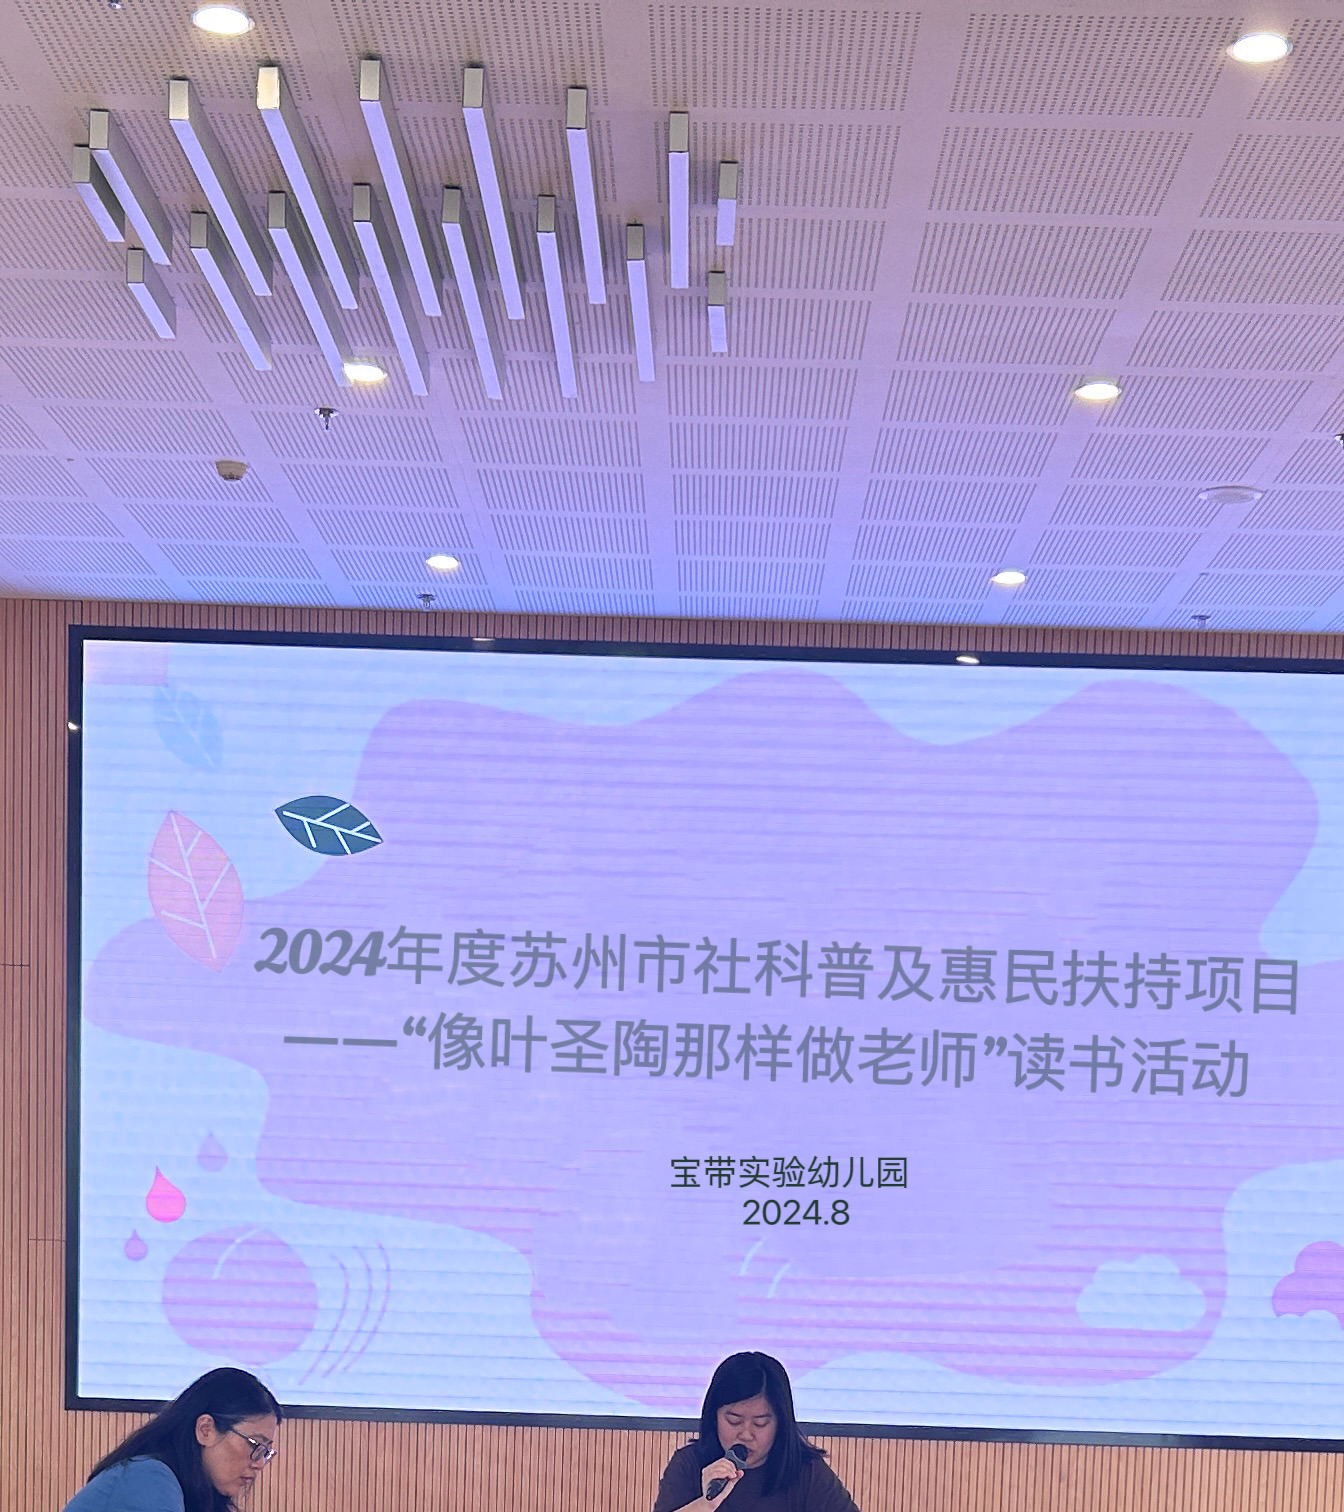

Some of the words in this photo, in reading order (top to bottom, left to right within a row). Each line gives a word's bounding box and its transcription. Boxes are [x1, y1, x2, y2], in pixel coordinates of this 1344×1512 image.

[254, 925, 1299, 1016] 2024年度苏州市社科普及惠民扶持项目
[670, 1156, 908, 1189] 宝带实验幼儿园
[742, 1199, 850, 1226] 2024.8
